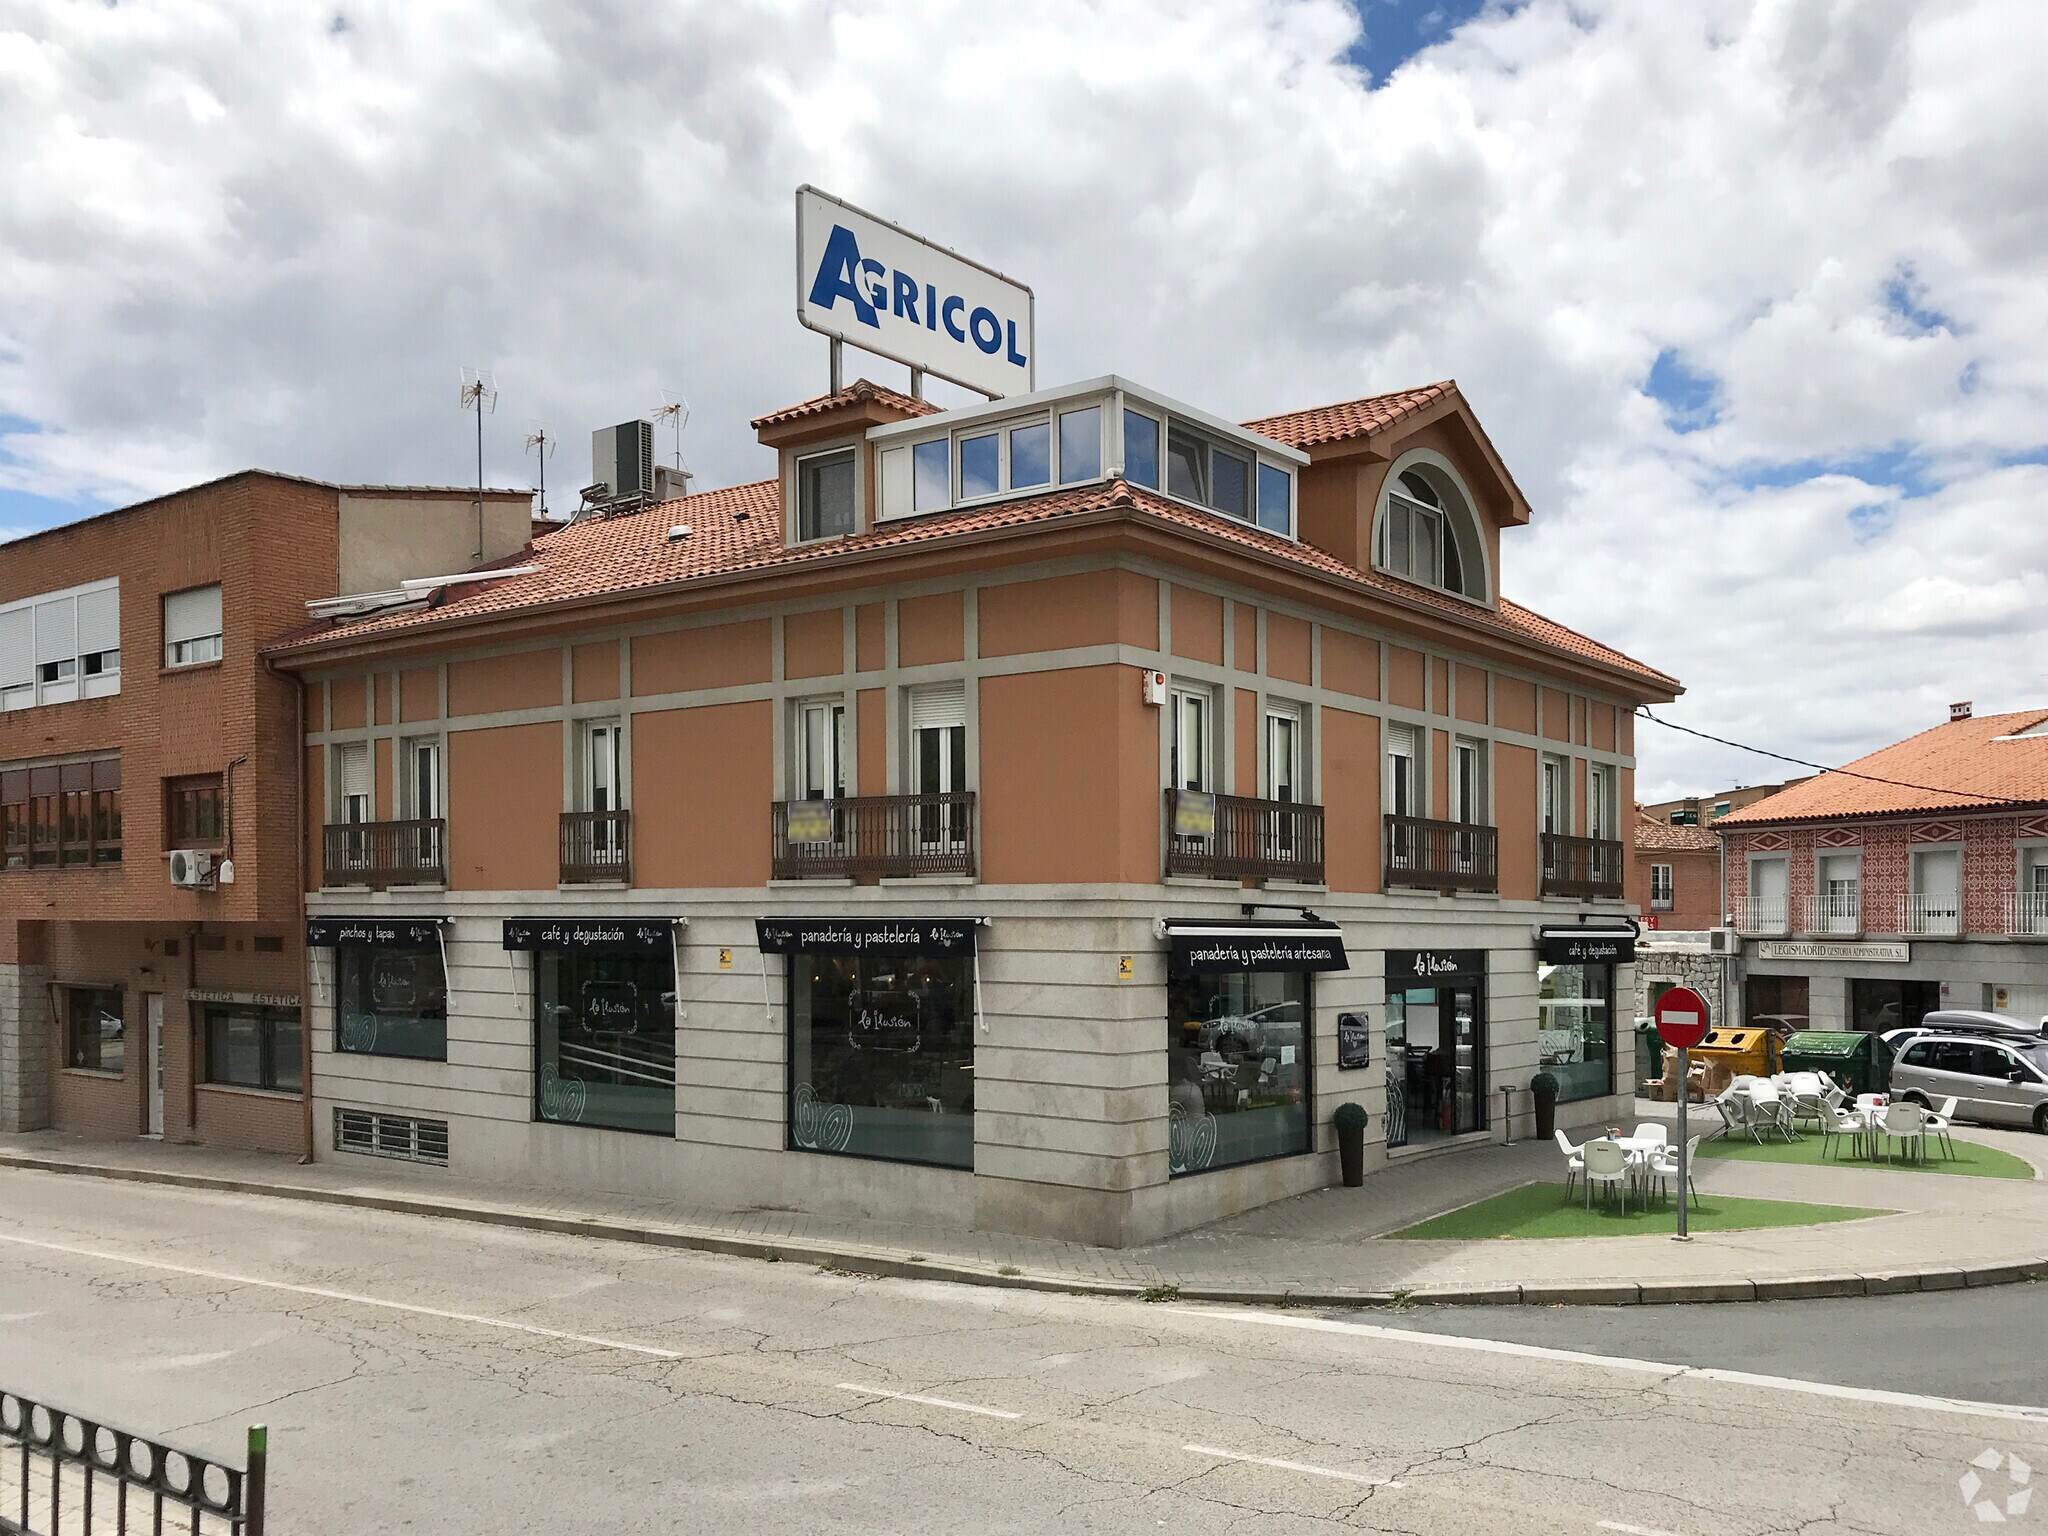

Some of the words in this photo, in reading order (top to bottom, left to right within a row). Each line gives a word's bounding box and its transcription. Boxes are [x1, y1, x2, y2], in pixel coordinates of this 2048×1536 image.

[808, 224, 1027, 368] AGRICOL
[339, 923, 367, 941] pinchos
[366, 930, 373, 943] y
[375, 924, 396, 943] tapas
[541, 925, 561, 941] café
[563, 932, 570, 945] y
[573, 925, 625, 946] degustación
[801, 925, 852, 947] panadería
[854, 933, 862, 949] y
[865, 924, 920, 948] pastelería
[1189, 943, 1240, 967] panadería
[1241, 949, 1249, 965] y
[1251, 941, 1293, 964] pastelería
[1294, 943, 1332, 960] artesana
[1568, 942, 1581, 956] café
[1582, 948, 1587, 960] y
[1588, 943, 1618, 960] degustación
[1774, 945, 1826, 956] LEGISMADRID
[188, 990, 234, 1001] ESTETICA
